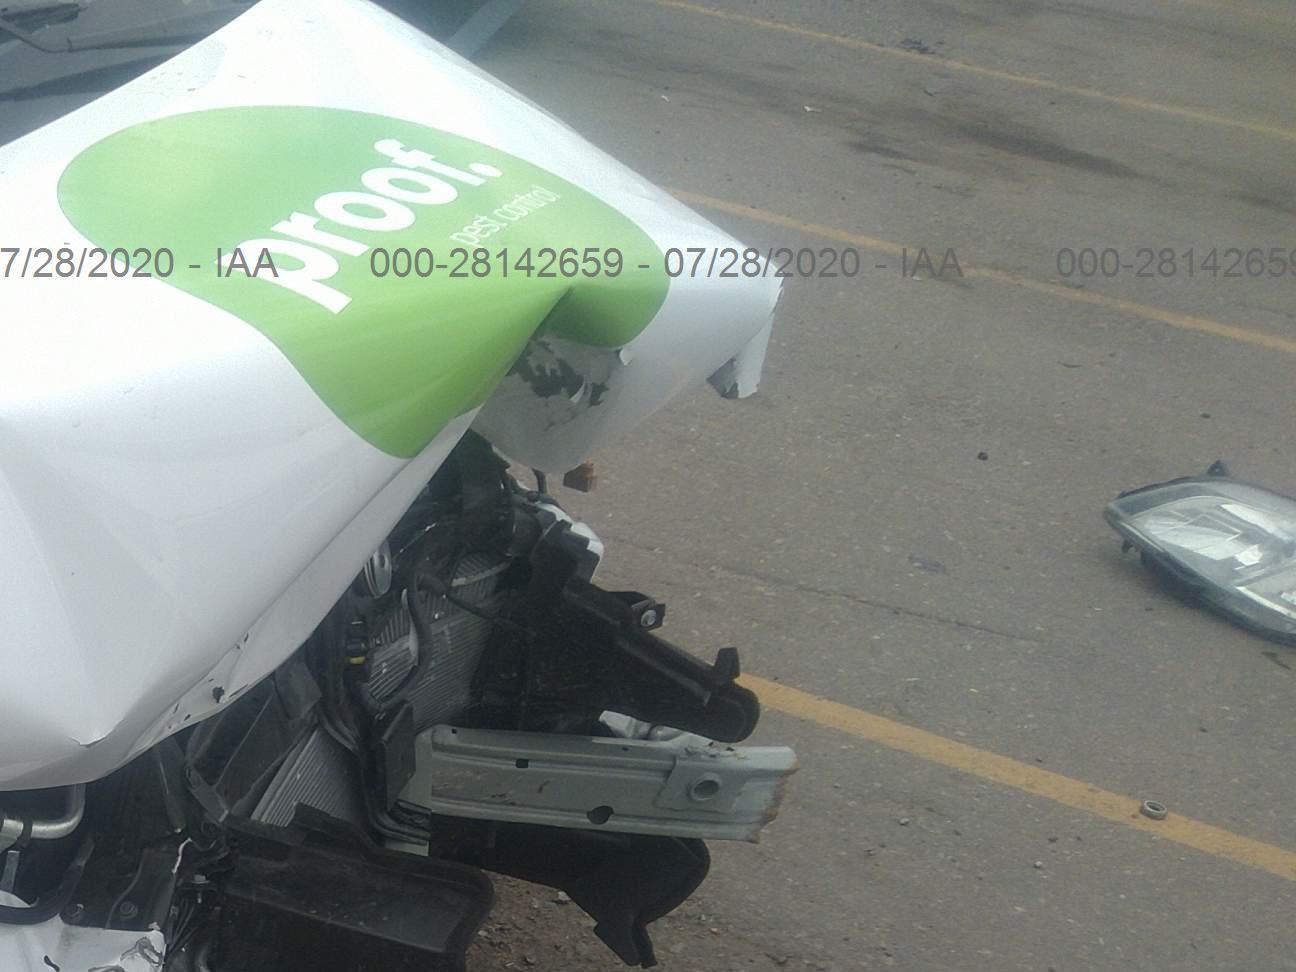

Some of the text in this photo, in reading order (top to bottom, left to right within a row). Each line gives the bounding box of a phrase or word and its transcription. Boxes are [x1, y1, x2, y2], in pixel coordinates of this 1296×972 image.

[214, 138, 503, 315] proof.
[449, 184, 561, 249] pest control
